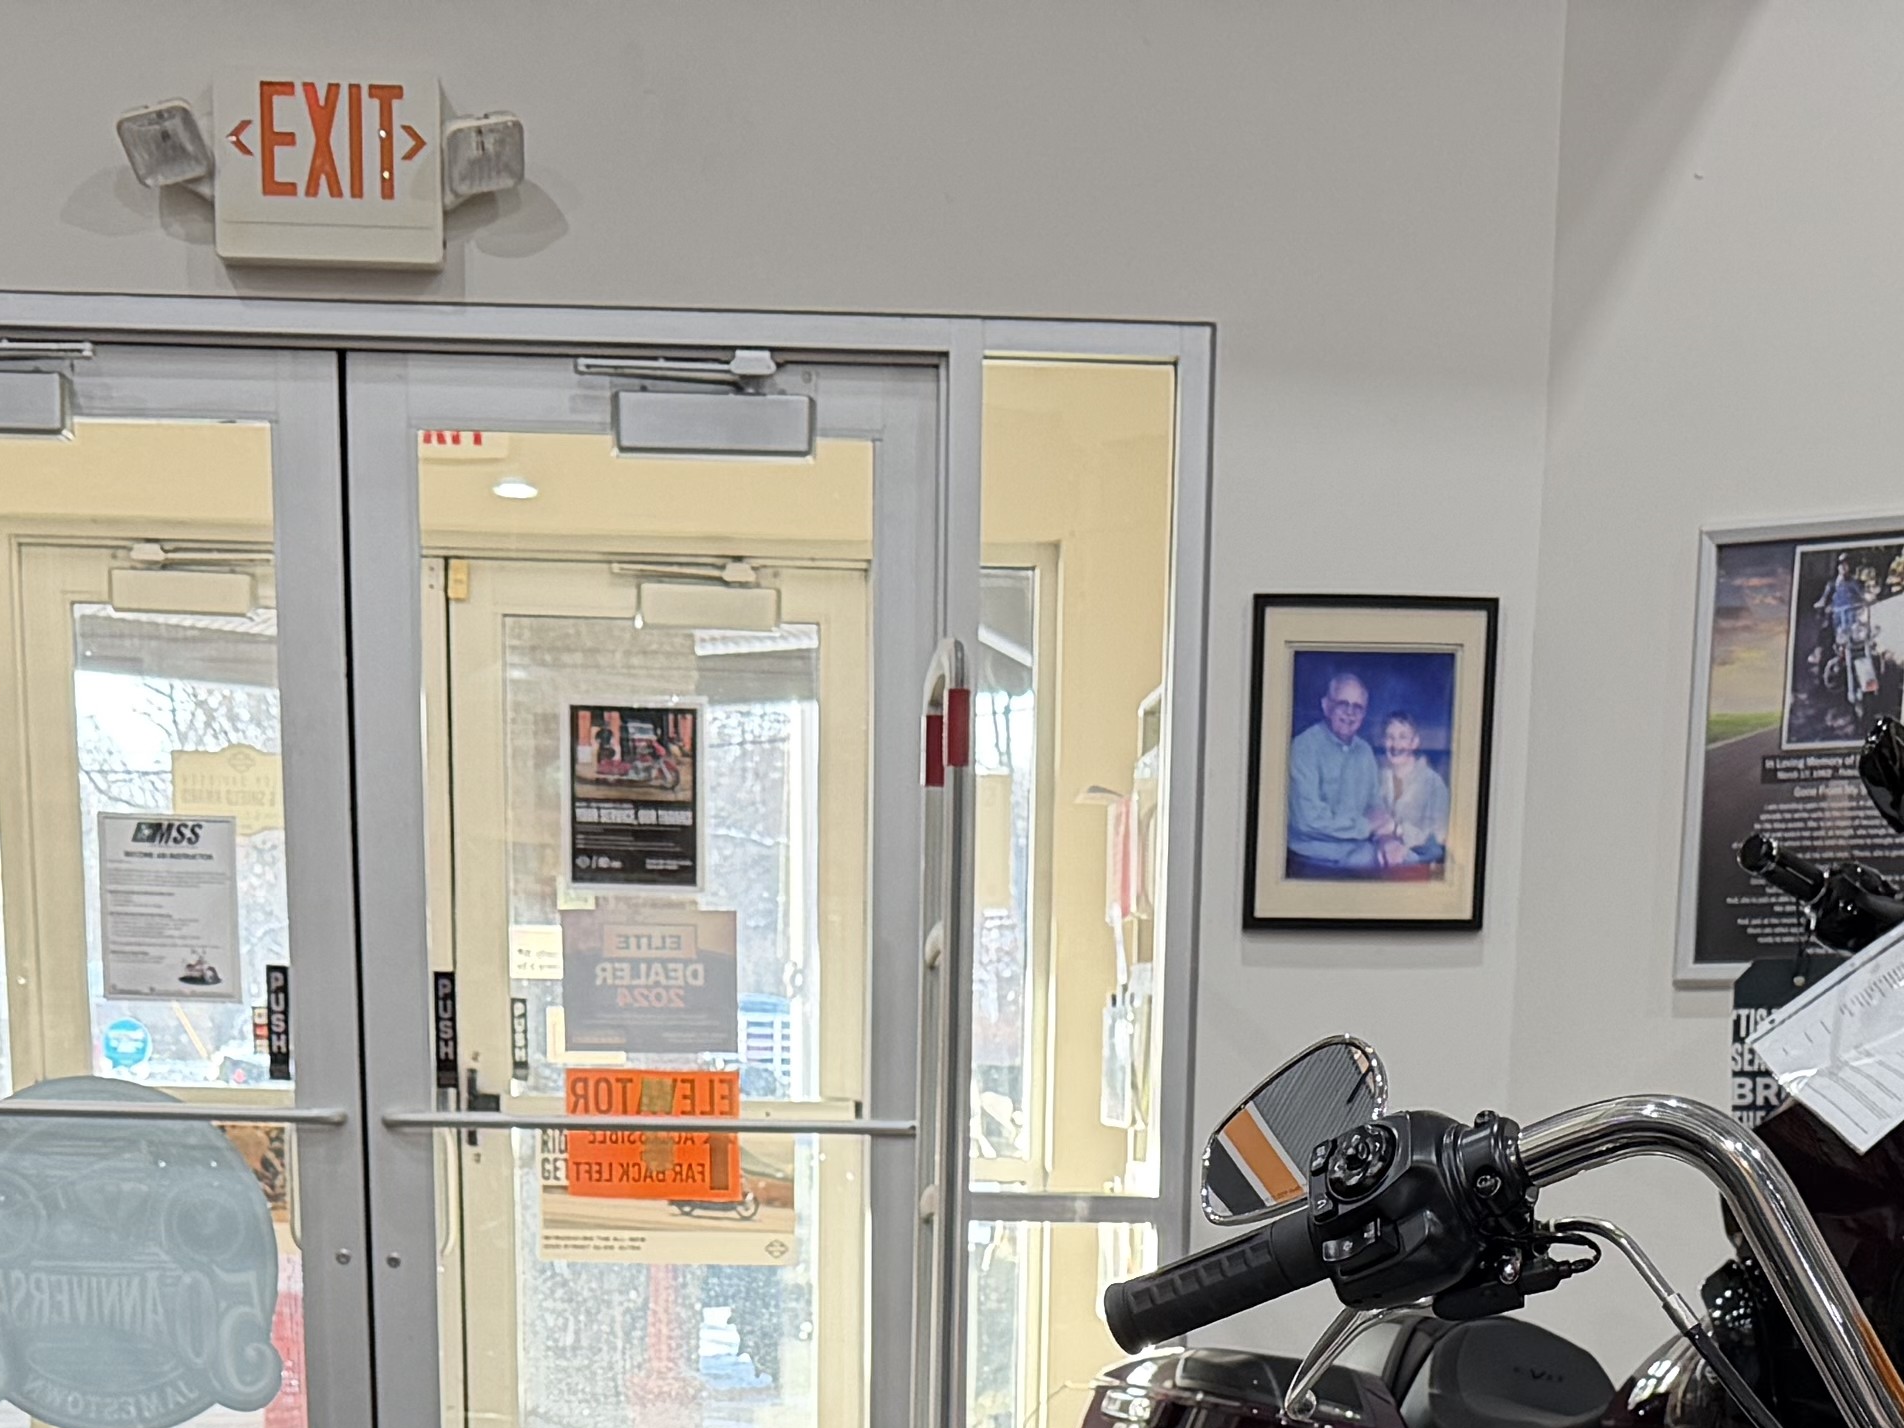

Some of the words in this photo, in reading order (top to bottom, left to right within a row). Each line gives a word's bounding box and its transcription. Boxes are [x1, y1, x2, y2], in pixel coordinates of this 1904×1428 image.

[259, 80, 404, 200] EXIT
[269, 971, 287, 1054] PUSH
[437, 977, 455, 1061] PUSH
[1732, 1076, 1788, 1106] BR
